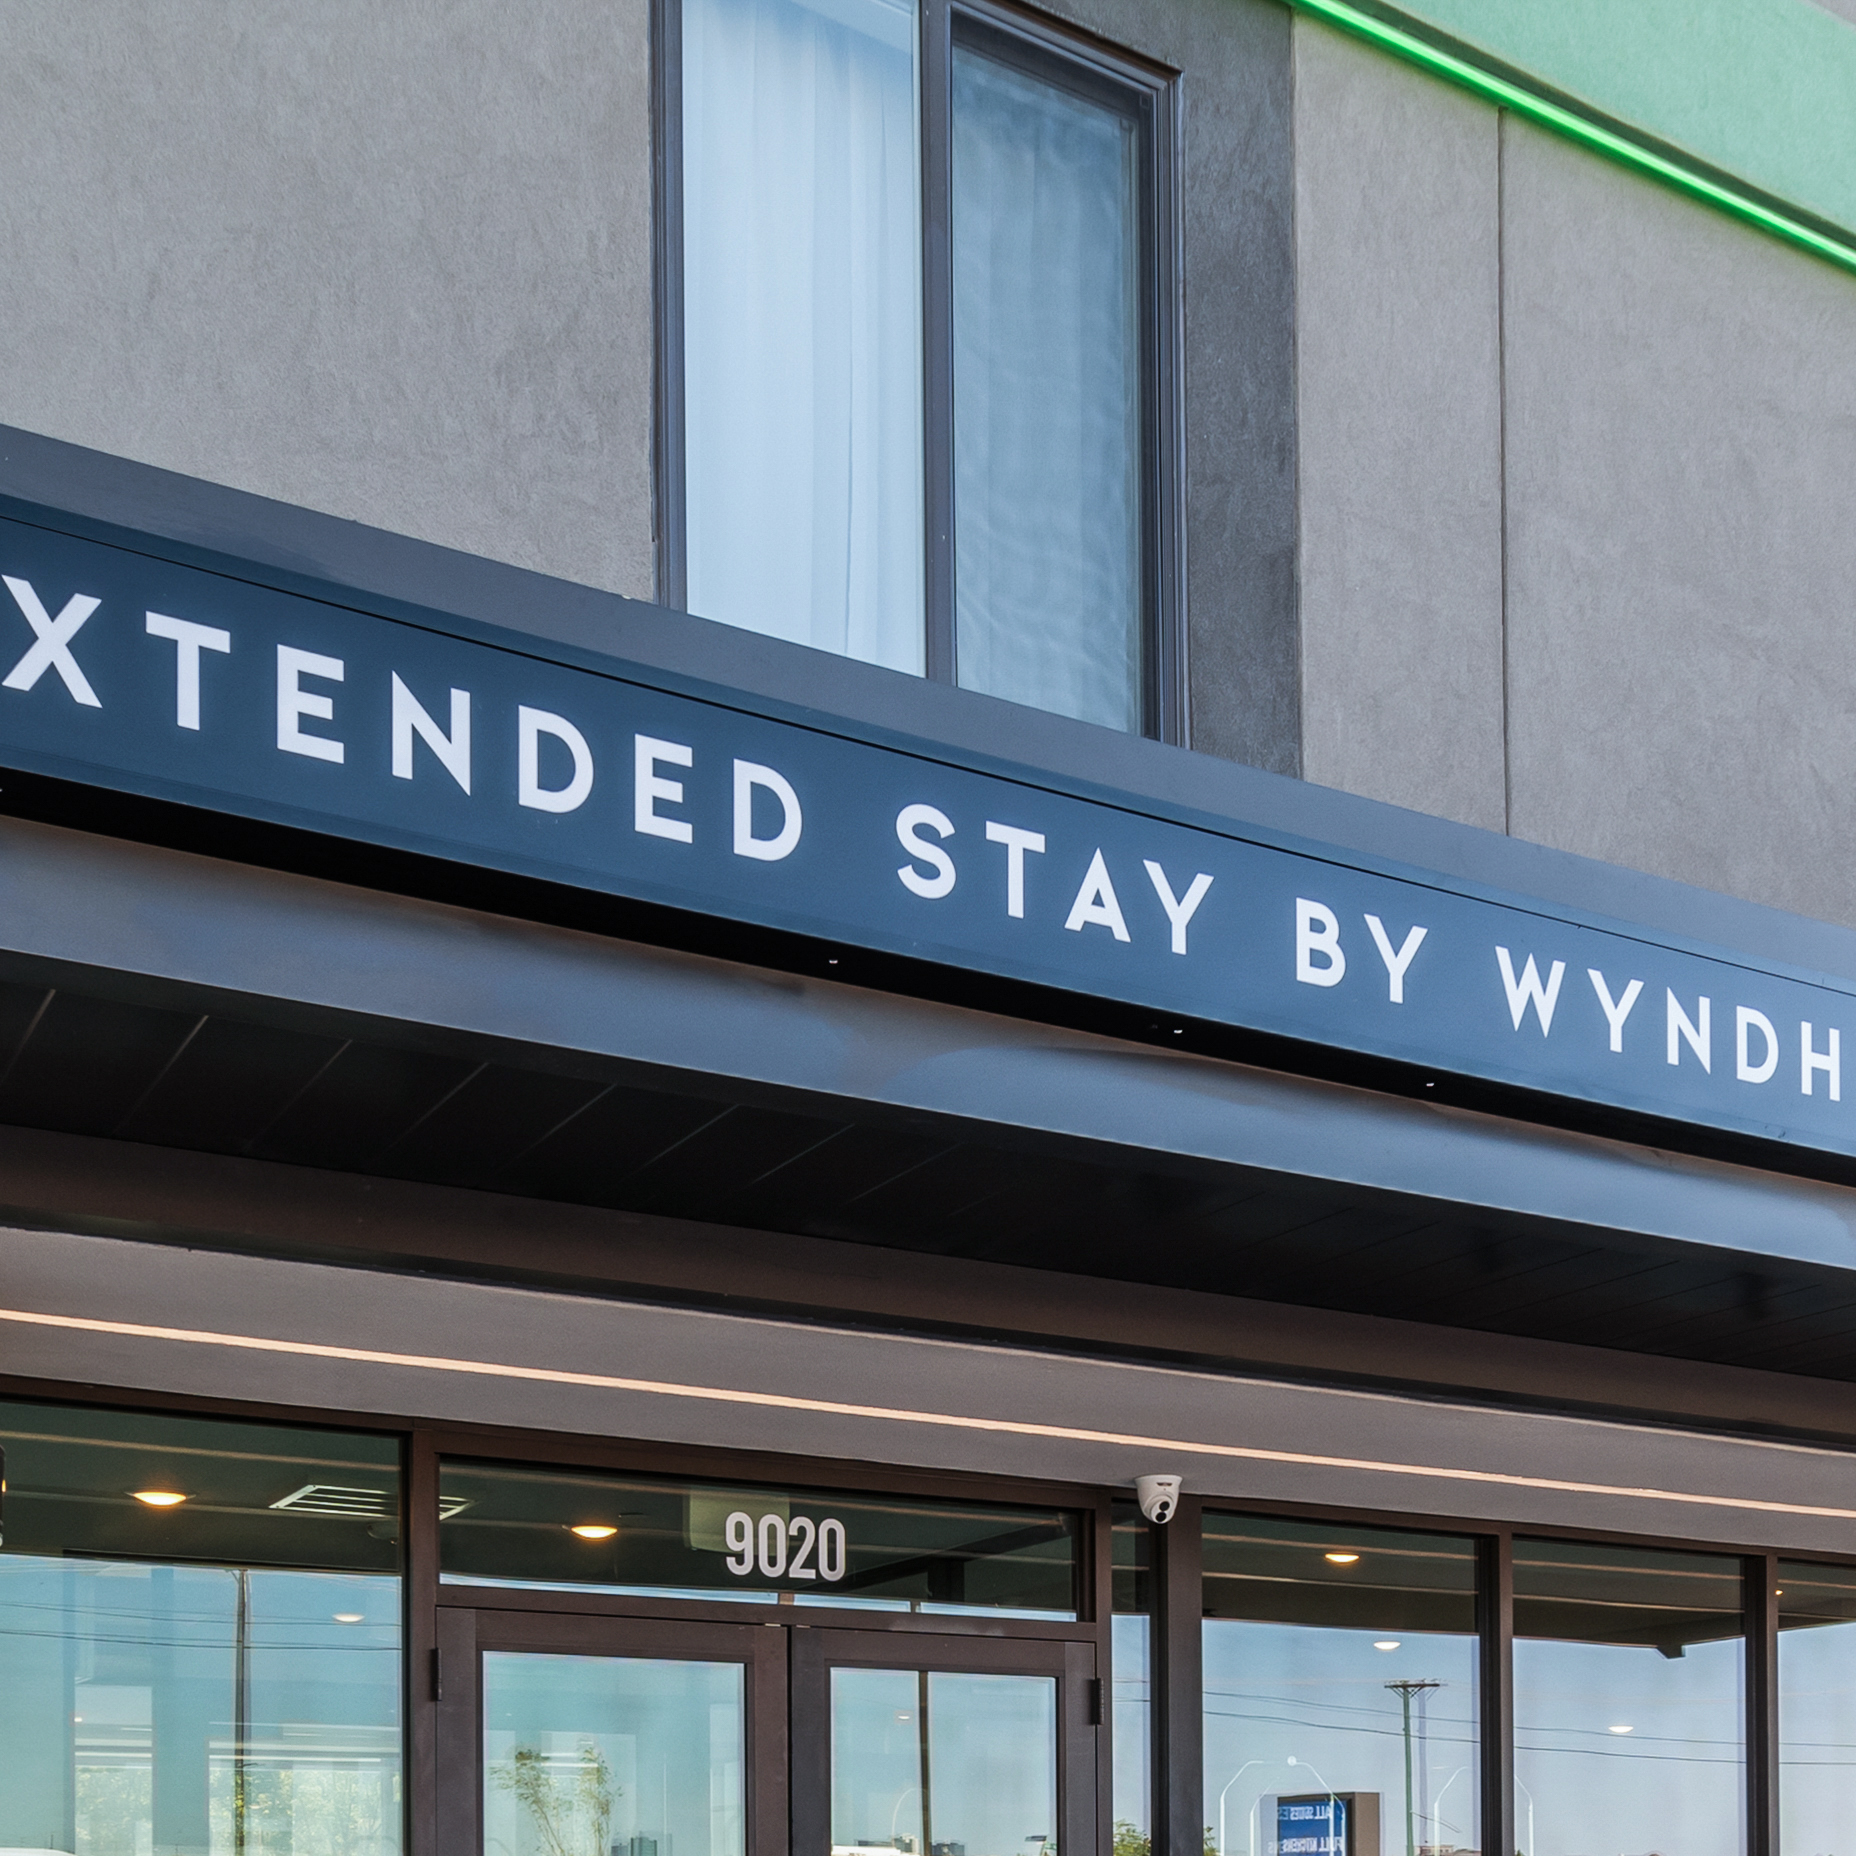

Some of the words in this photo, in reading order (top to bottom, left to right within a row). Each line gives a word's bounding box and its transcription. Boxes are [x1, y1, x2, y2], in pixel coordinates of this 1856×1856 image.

[896, 803, 1214, 955] STAY
[1295, 897, 1428, 1004] BY
[725, 1511, 846, 1581] 9020
